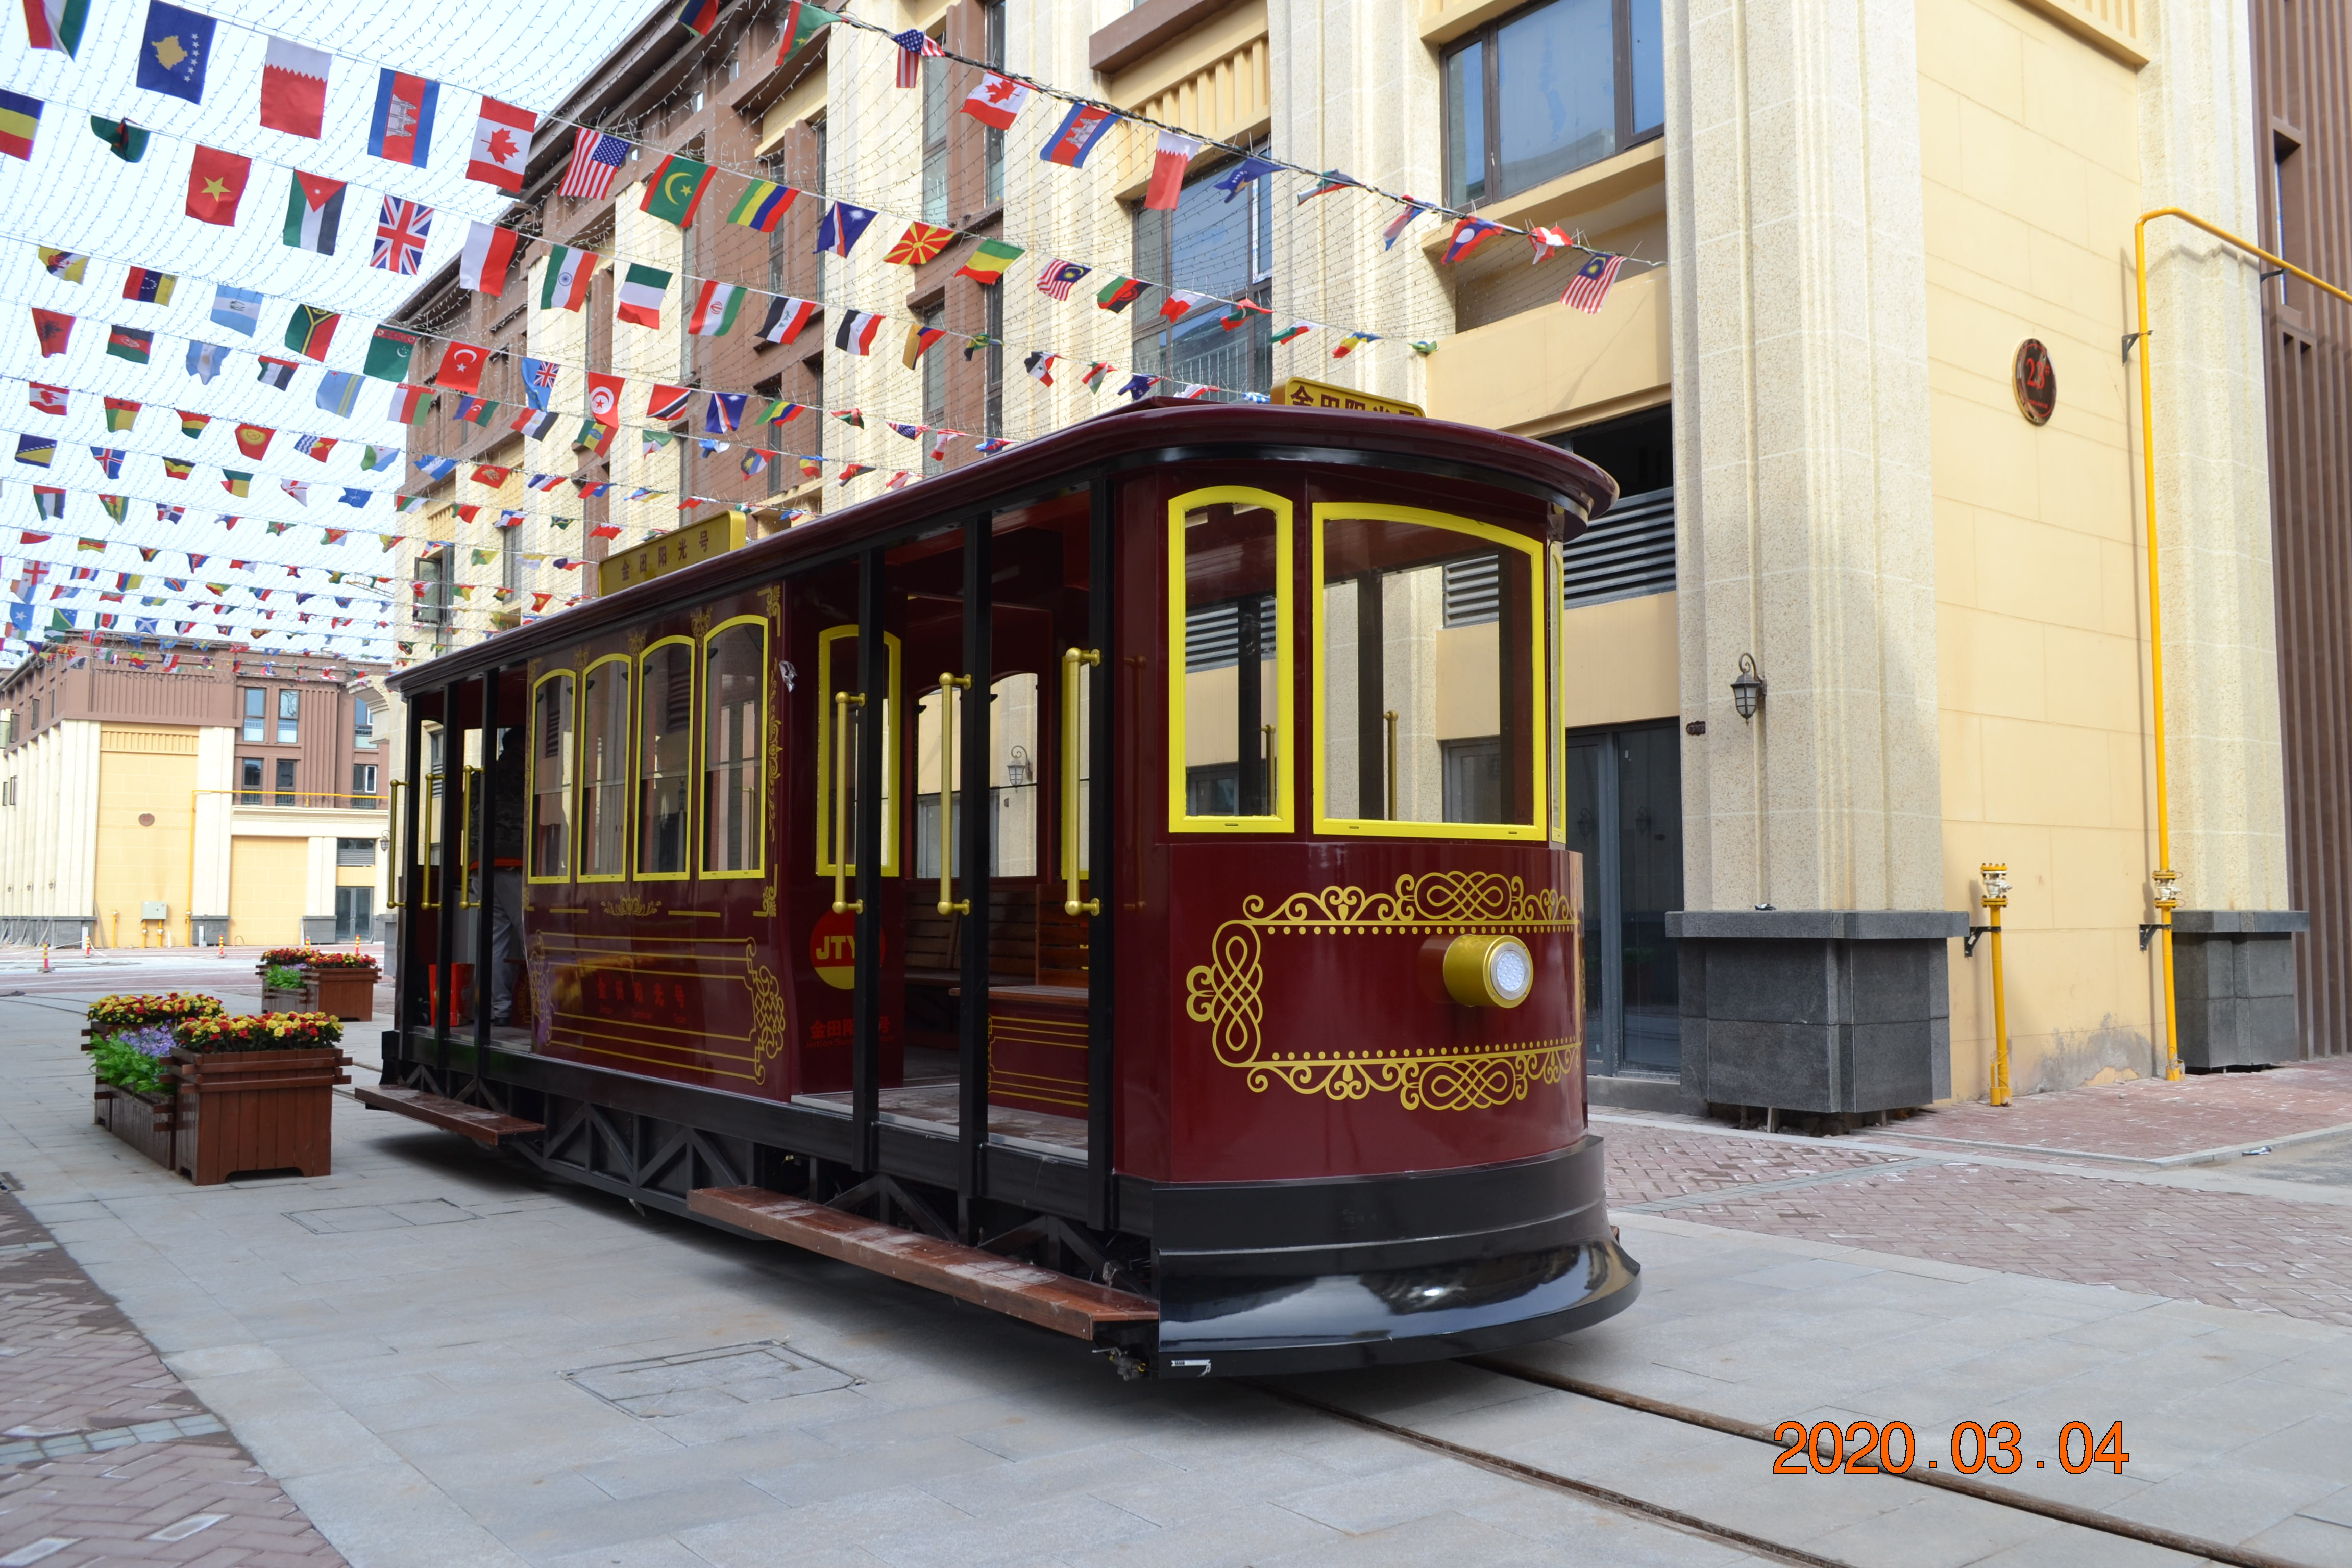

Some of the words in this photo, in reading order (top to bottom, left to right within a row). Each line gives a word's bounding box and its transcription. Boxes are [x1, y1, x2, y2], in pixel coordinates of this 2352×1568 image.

[621, 530, 709, 581] 金田阳光号
[597, 976, 685, 1009] 金田阳光号
